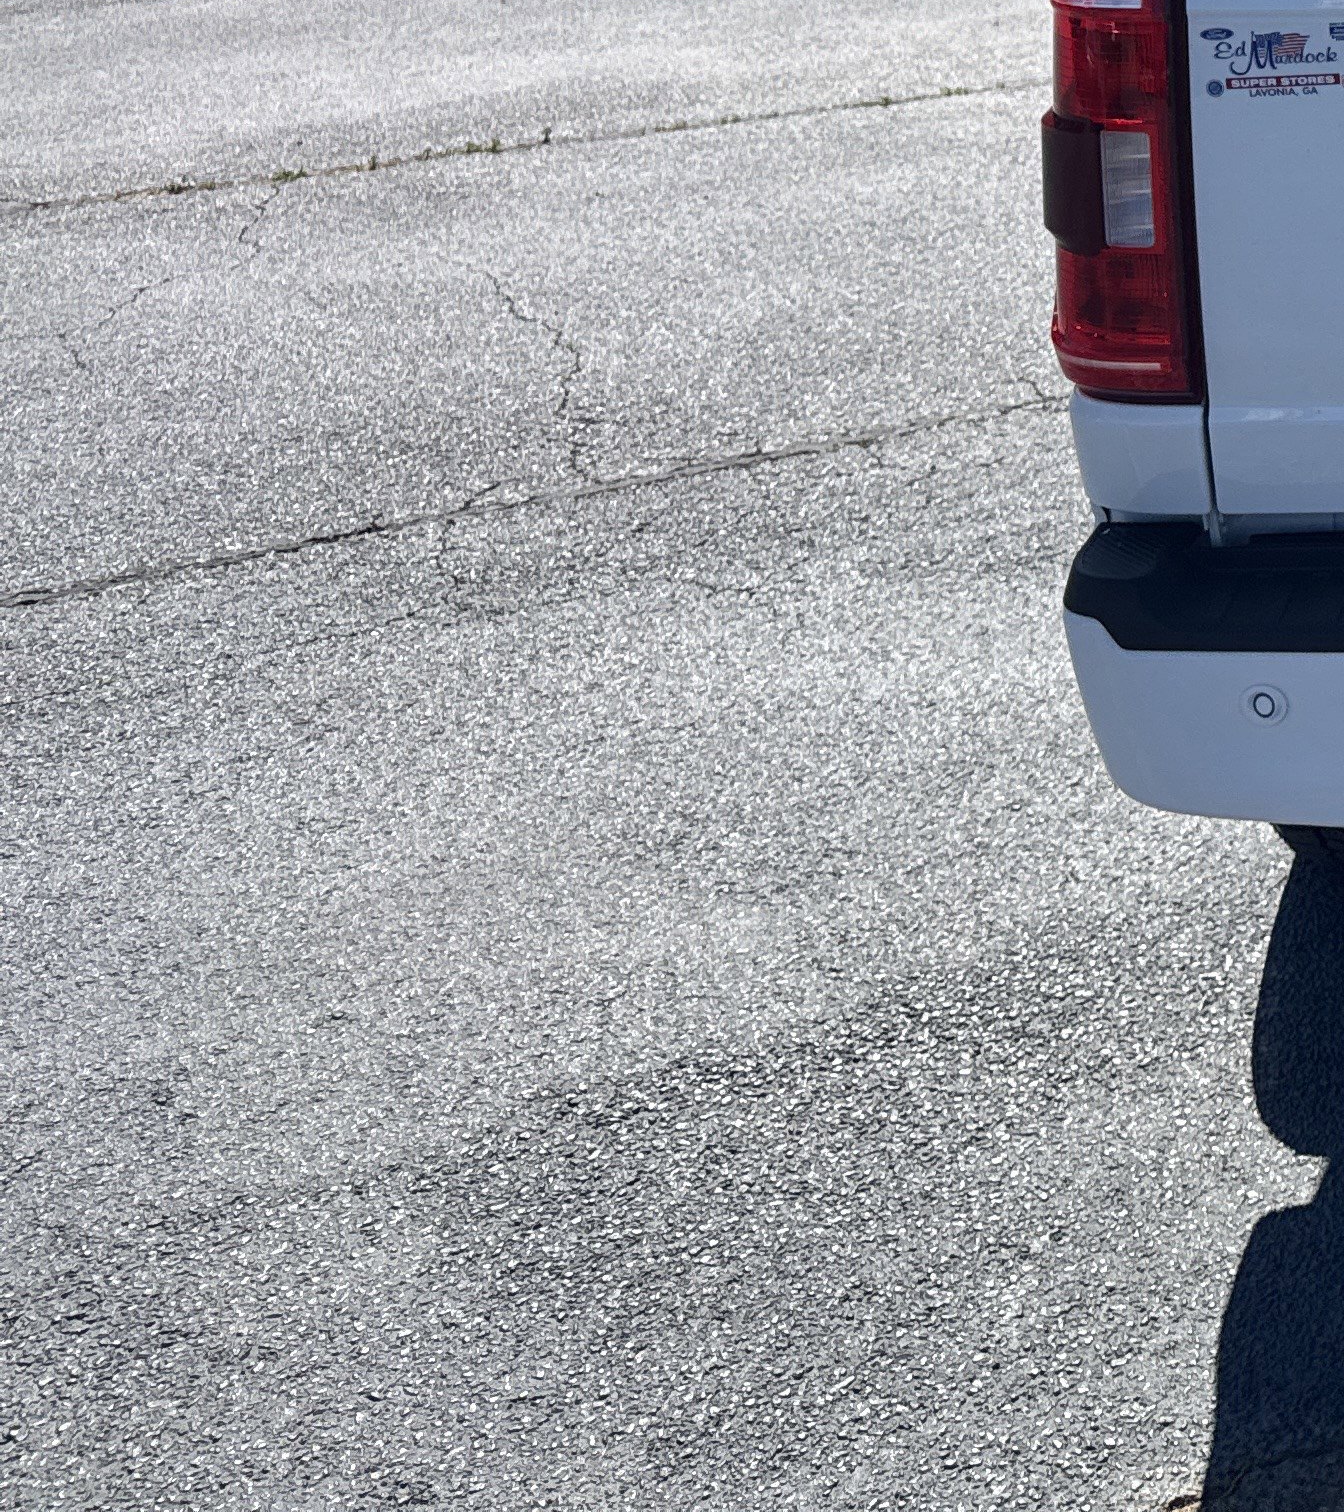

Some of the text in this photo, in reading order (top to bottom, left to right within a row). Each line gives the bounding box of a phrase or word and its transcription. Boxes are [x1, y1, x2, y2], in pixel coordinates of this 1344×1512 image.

[1214, 41, 1247, 59] Ed
[1230, 74, 1336, 88] SUPER STORES
[1250, 86, 1318, 98] LAVONIA, GA
